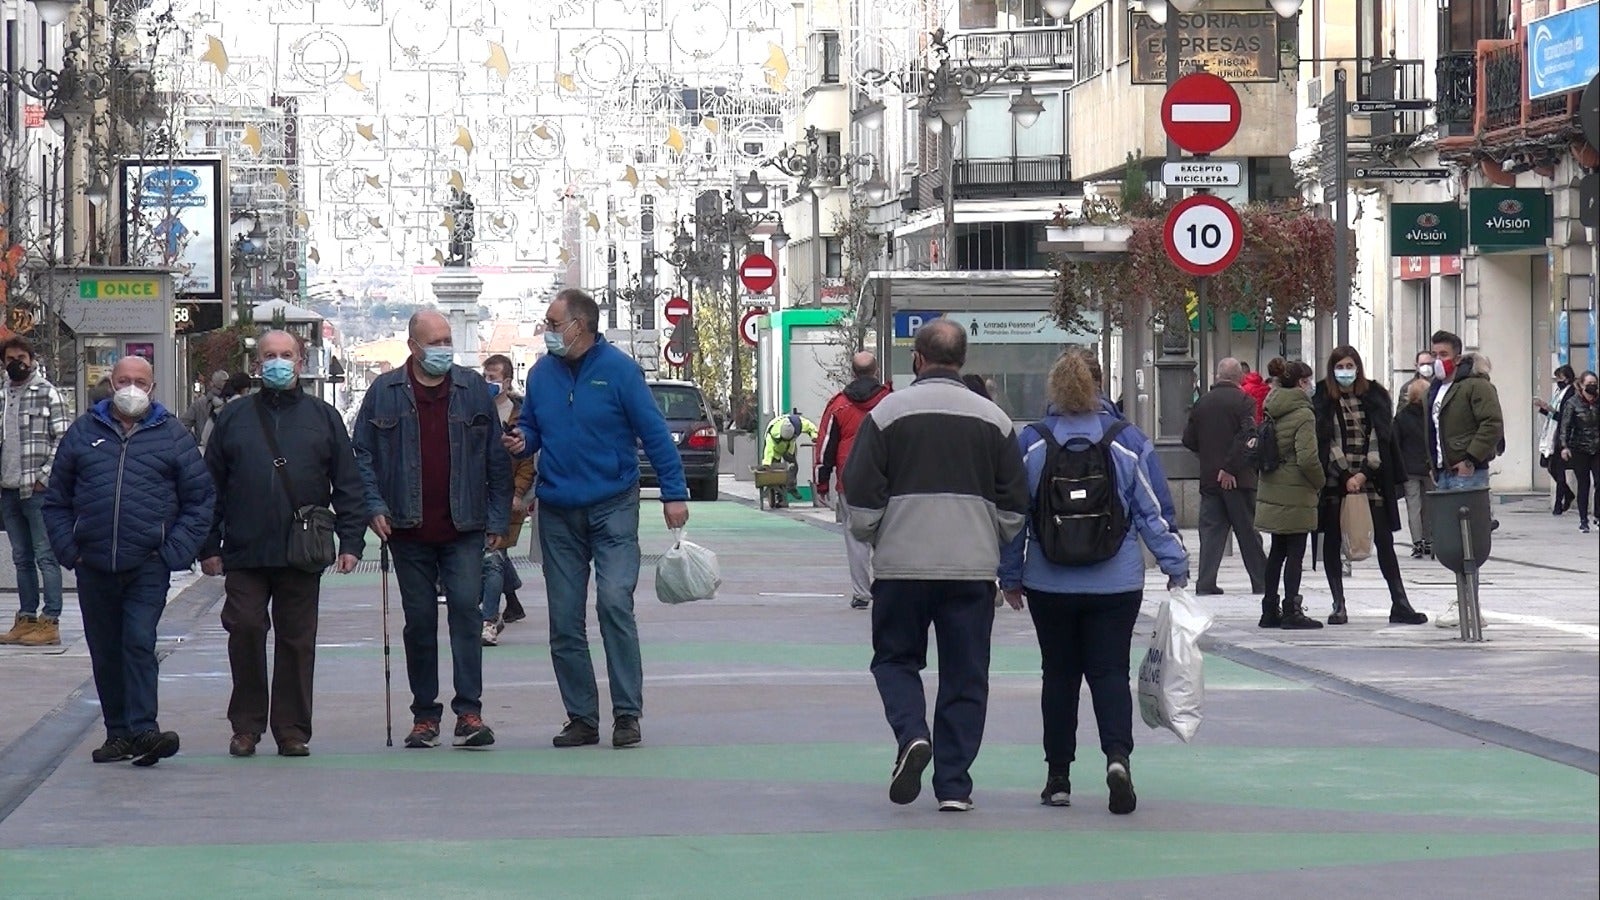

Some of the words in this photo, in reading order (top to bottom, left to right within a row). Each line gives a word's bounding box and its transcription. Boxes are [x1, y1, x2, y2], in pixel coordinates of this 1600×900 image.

[1136, 14, 1240, 29] ASSORIA
[1247, 14, 1274, 28] DE
[1148, 36, 1261, 53] EPRESAS
[1157, 57, 1210, 67] CTABLE
[1186, 223, 1222, 249] 10
[103, 283, 153, 296] ONCE
[174, 308, 190, 322] 58
[908, 315, 923, 337] P
[983, 321, 1008, 329] Entrada
[1147, 648, 1163, 665] NDA
